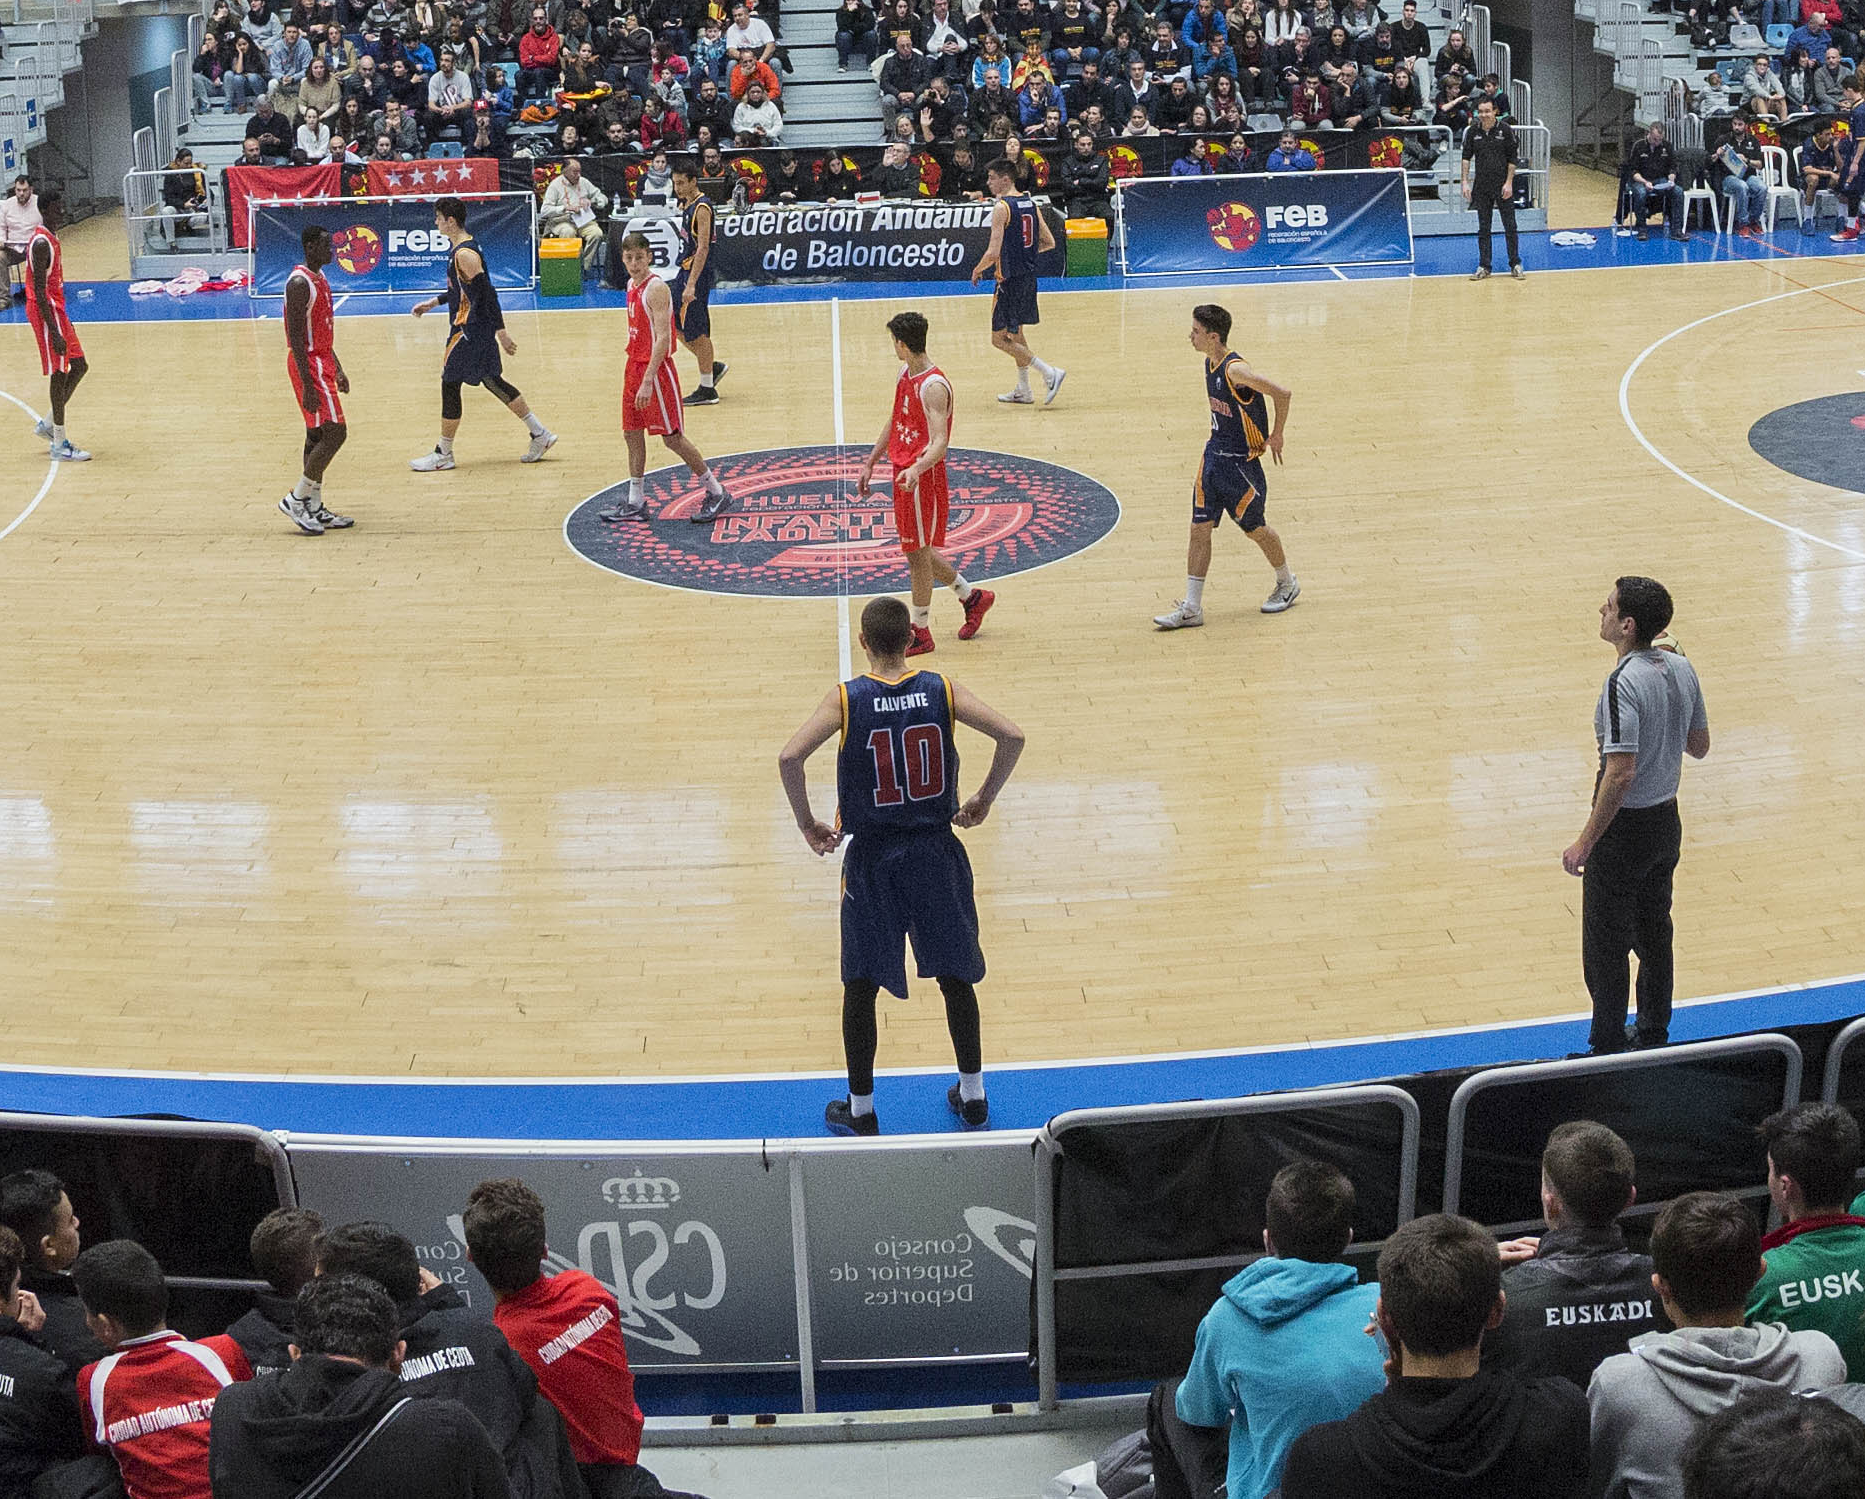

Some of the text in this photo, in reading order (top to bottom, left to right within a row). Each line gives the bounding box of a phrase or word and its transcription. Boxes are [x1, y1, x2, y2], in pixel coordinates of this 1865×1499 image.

[762, 238, 965, 271] de Baloncesto
[743, 493, 891, 508] HUELVA
[710, 525, 898, 543] CADETE
[873, 693, 929, 712] CALVENTE
[866, 723, 945, 807] 10
[1544, 1299, 1654, 1328] EUSKADI
[433, 1346, 476, 1372] DE CEUTA
[108, 1400, 202, 1444] CIUDAD AUTÓNOMA DE
